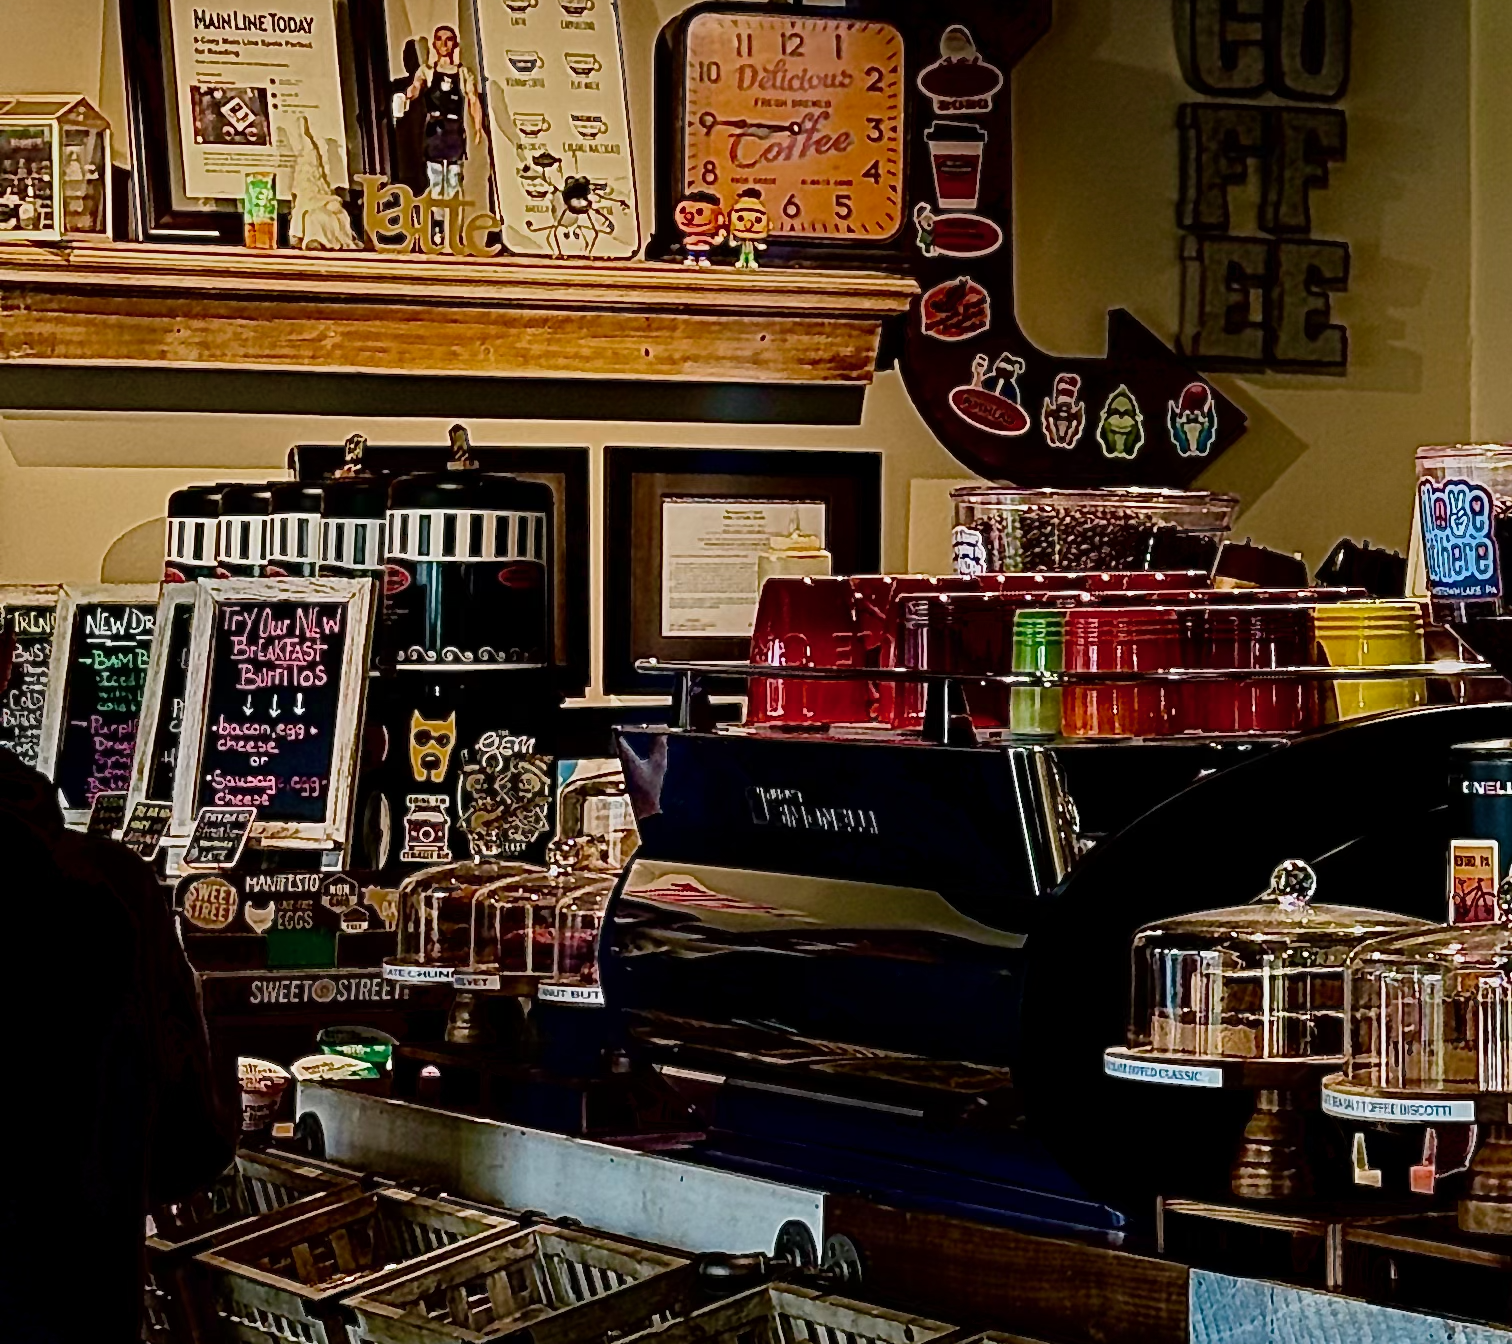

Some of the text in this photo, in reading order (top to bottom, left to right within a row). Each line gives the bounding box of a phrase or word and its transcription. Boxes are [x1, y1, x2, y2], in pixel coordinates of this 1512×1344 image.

[736, 32, 842, 60] 11 12 1
[699, 59, 884, 92] 10 Delicious 2
[728, 110, 851, 169] Coffee
[866, 117, 884, 142] 3
[702, 160, 881, 185] 8 4
[783, 194, 851, 220] 6 5
[86, 608, 129, 635] NEW
[92, 649, 133, 669] BAM
[217, 738, 279, 754] cheese
[250, 756, 269, 767] or
[214, 792, 270, 806] cheese
[189, 882, 237, 903] SWEET
[245, 874, 319, 893] MANIFESTO
[185, 903, 237, 922] STREET
[277, 912, 313, 930] EGGS
[250, 978, 400, 1004] SWEET STREET
[1159, 1069, 1203, 1081] CLASSIC
